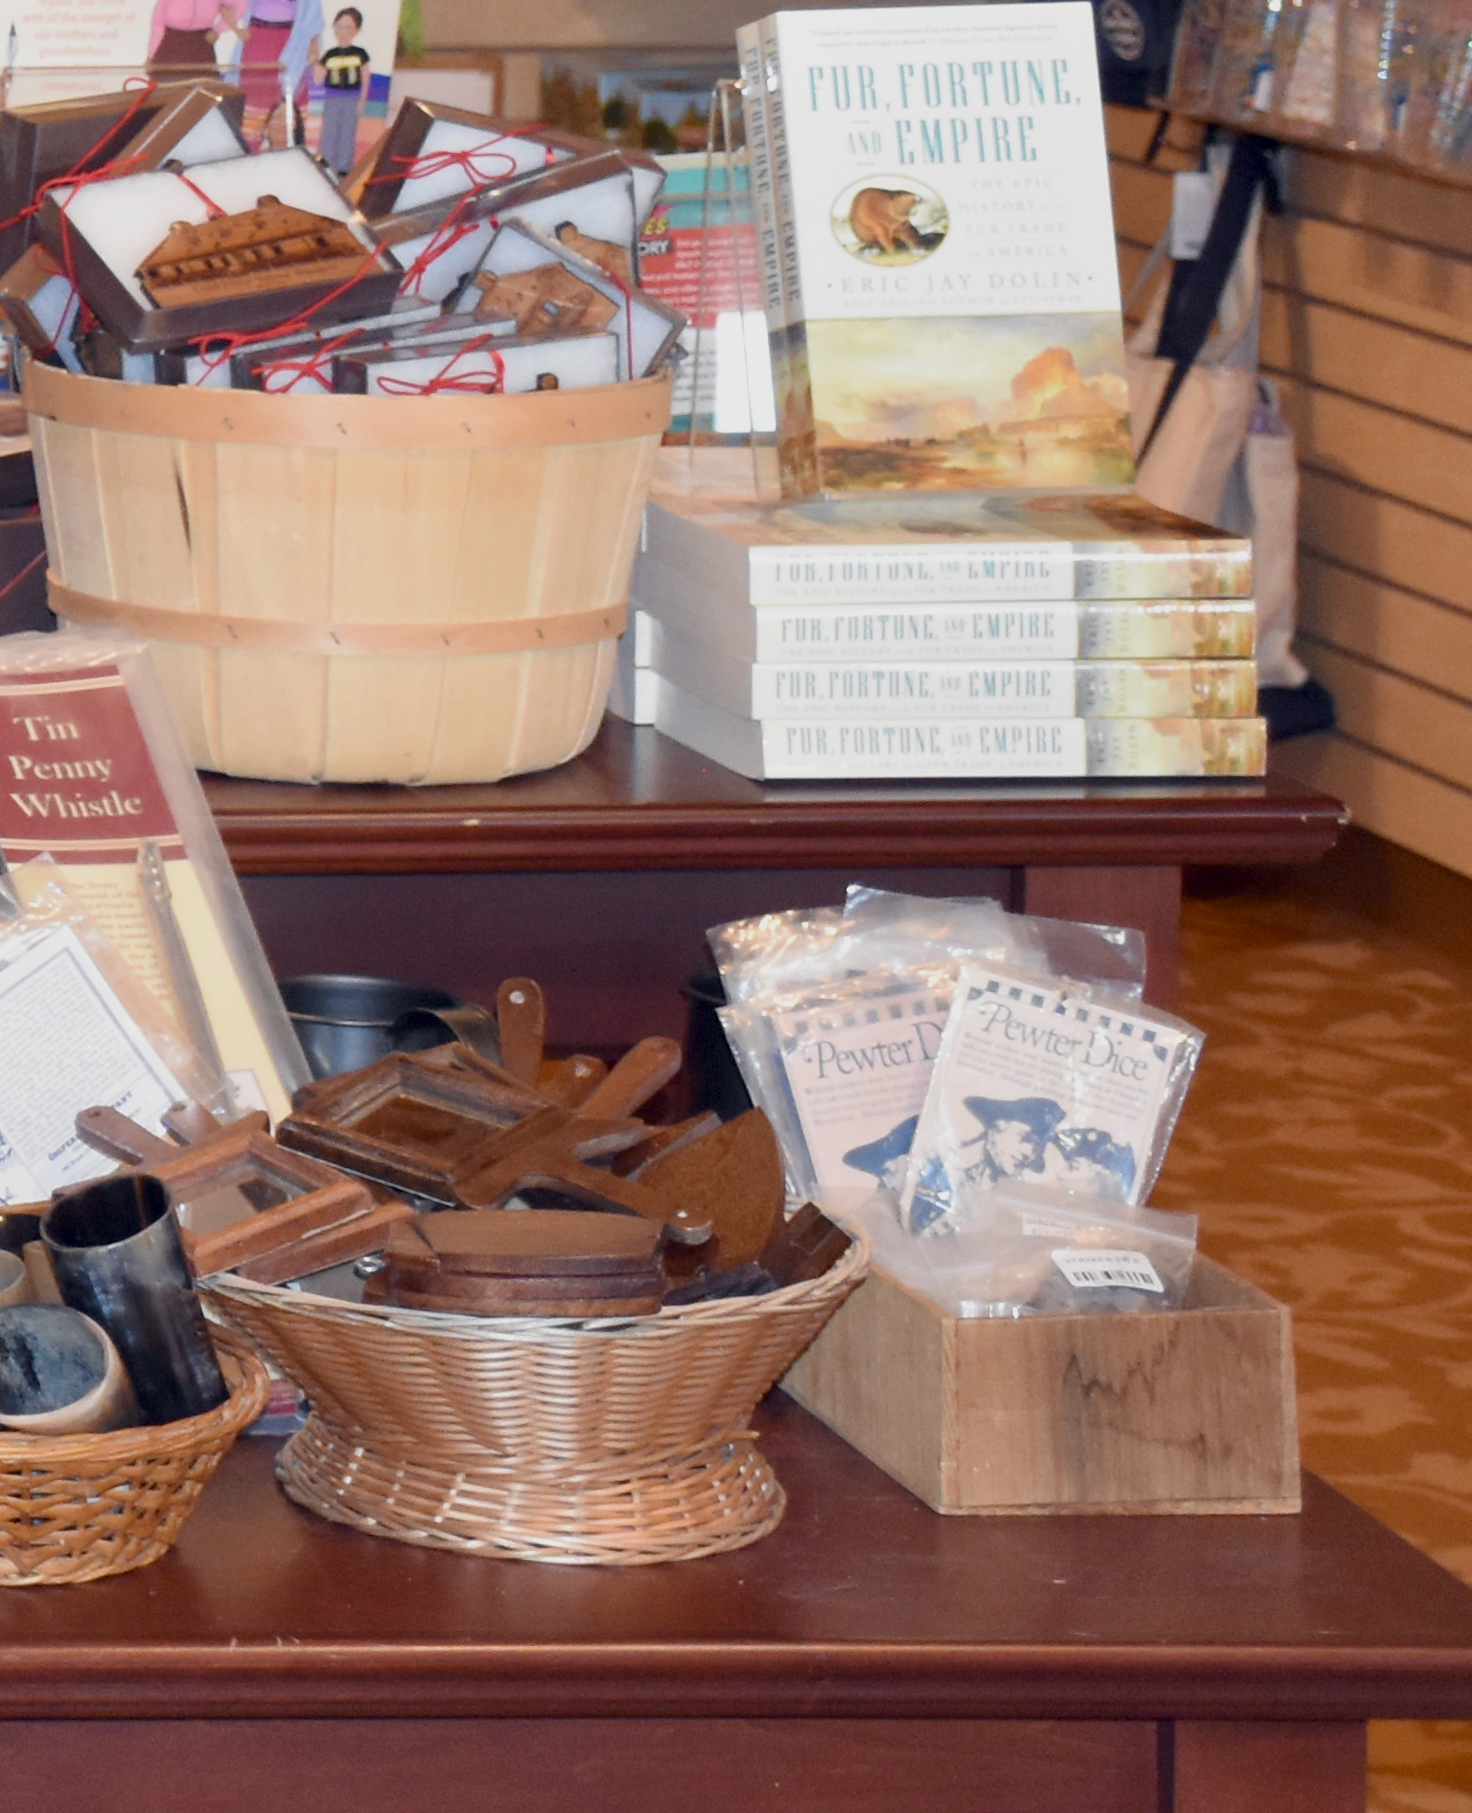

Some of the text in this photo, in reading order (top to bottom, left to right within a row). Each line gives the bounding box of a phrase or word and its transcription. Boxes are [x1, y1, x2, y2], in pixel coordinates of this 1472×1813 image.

[807, 58, 1082, 112] FUR, FORTUNE,
[847, 115, 1038, 166] AND EMPIRE
[841, 270, 1083, 294] ERIC JAY DOLIN
[972, 610, 1055, 640] EMPIRE
[968, 669, 1052, 698] EMPIRE
[11, 715, 81, 742] Tin
[979, 725, 1062, 755] EMPIRE
[7, 754, 113, 783] Penny
[9, 789, 144, 819] Whistle
[978, 1000, 1151, 1082] Pewter Dice
[802, 1037, 915, 1080] Pewter
